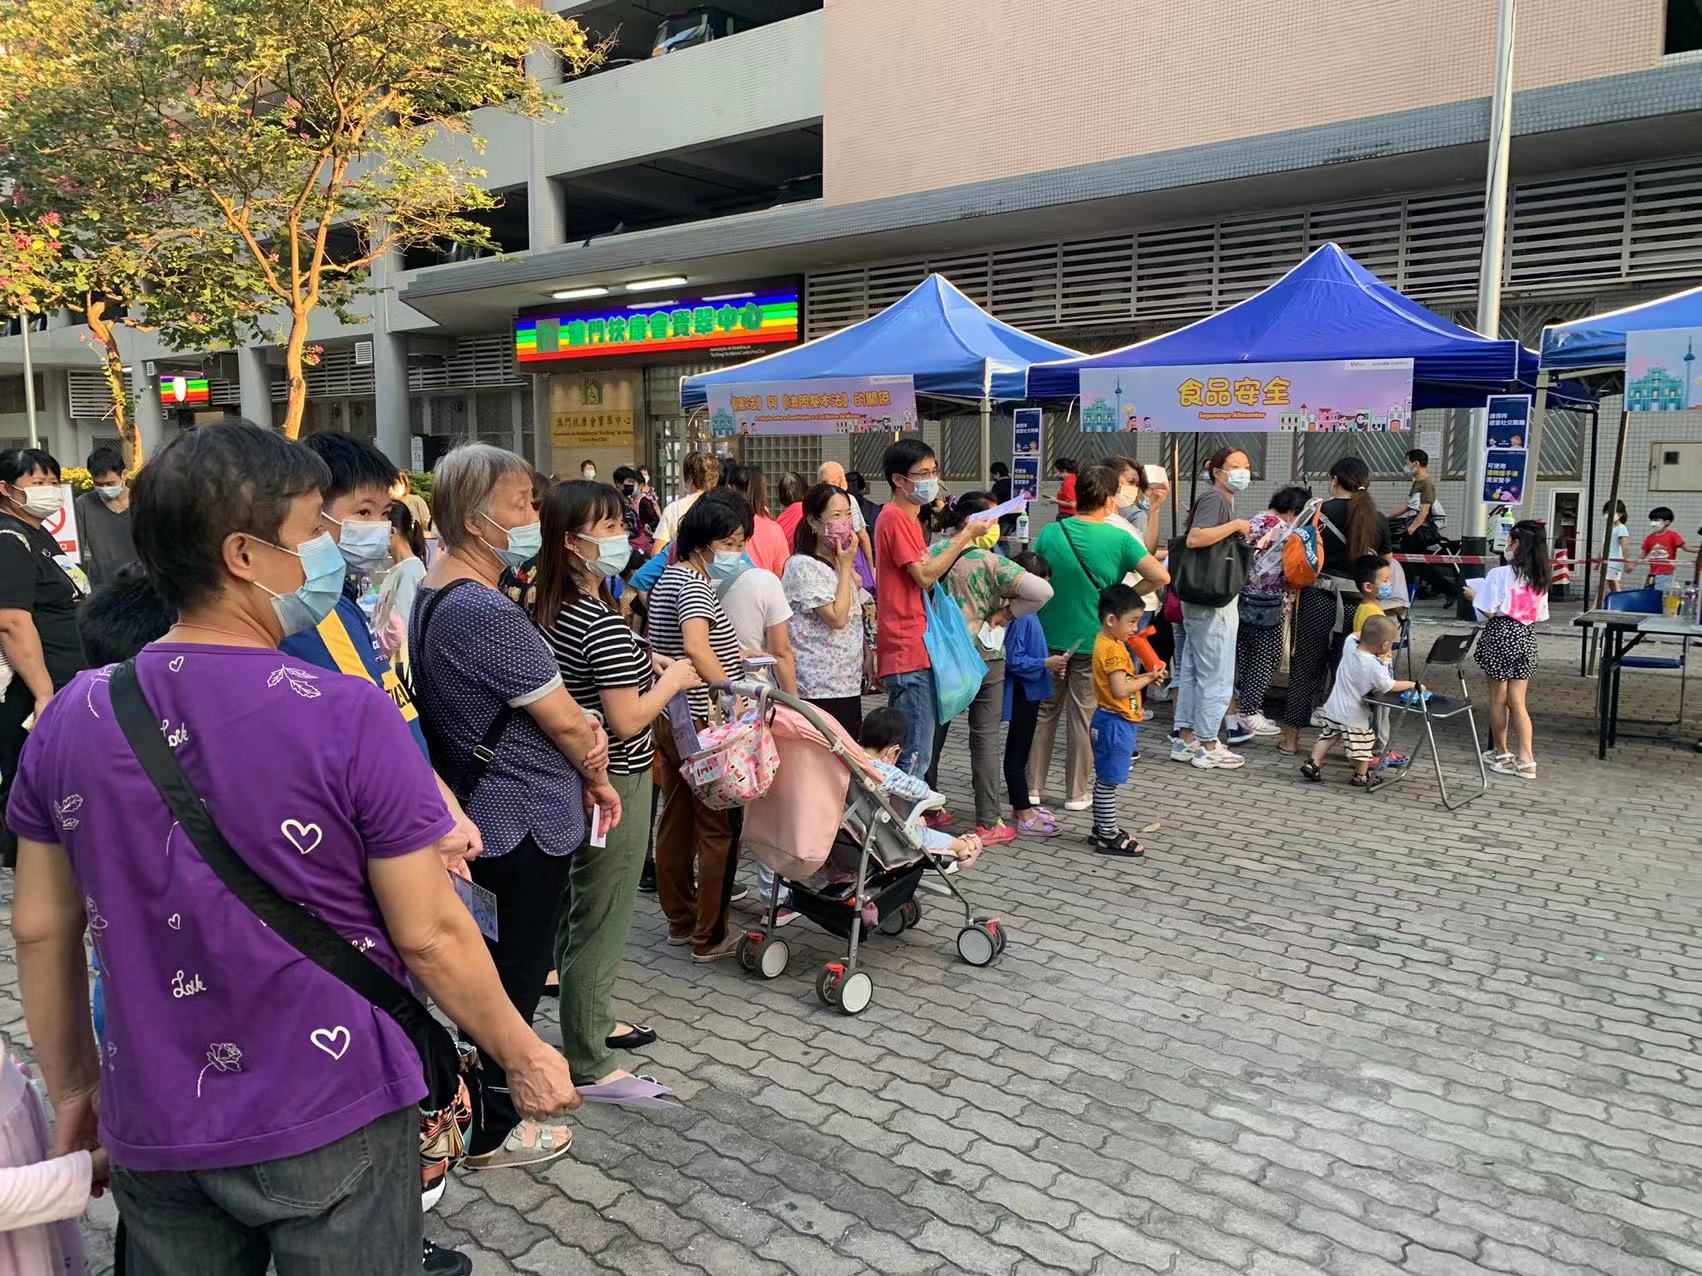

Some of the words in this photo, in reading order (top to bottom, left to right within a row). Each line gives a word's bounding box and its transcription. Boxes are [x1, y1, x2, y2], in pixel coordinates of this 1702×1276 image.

[1177, 376, 1291, 406] 食品安全
[1487, 462, 1507, 470] 可使用
